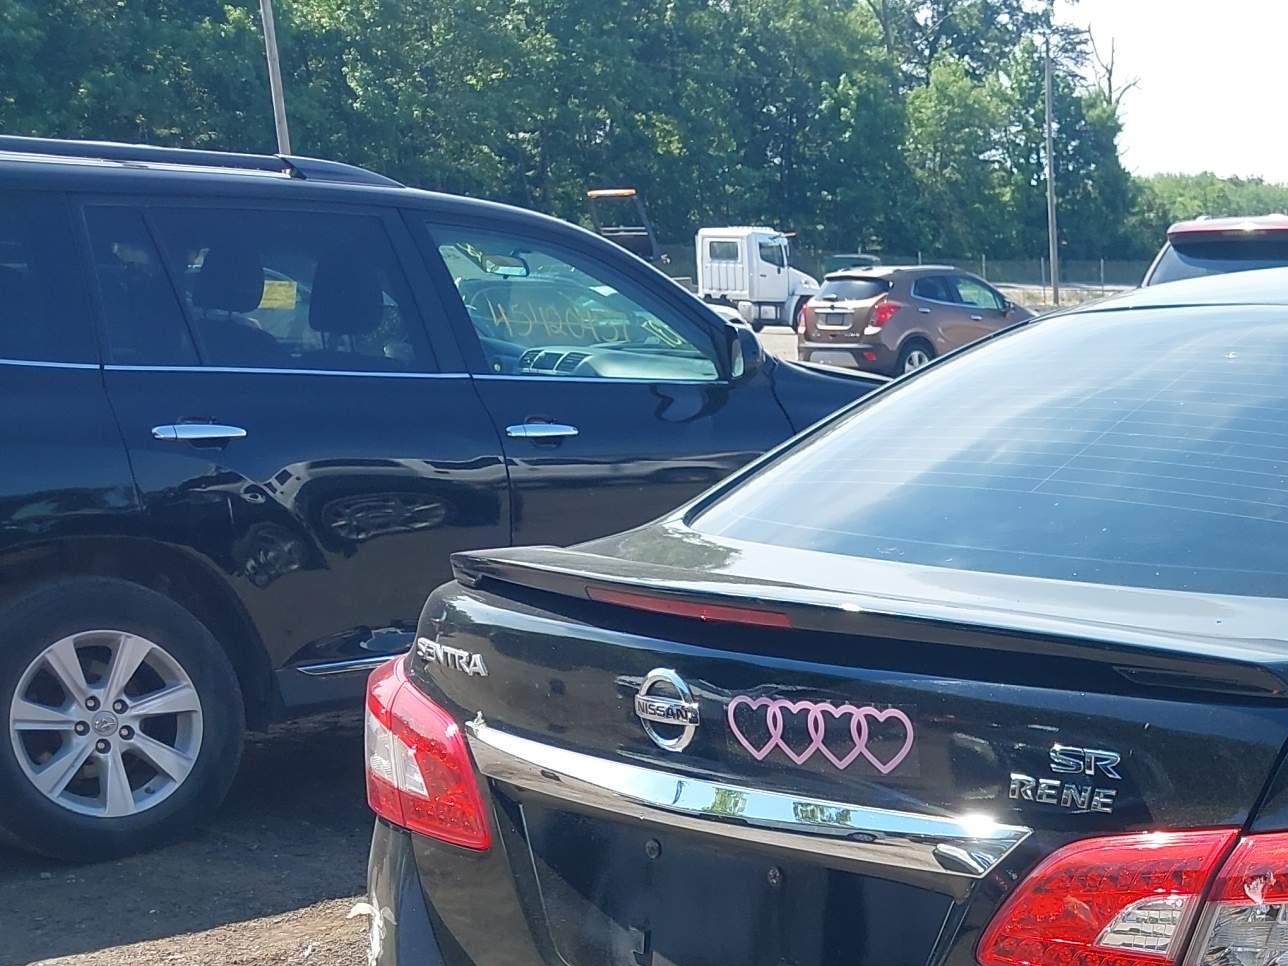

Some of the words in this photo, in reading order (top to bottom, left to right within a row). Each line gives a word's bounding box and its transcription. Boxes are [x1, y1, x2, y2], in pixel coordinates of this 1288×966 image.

[416, 637, 489, 677] SENTRA
[637, 701, 689, 720] NISSAN
[1049, 743, 1122, 779] SR
[1008, 772, 1117, 813] RENE
